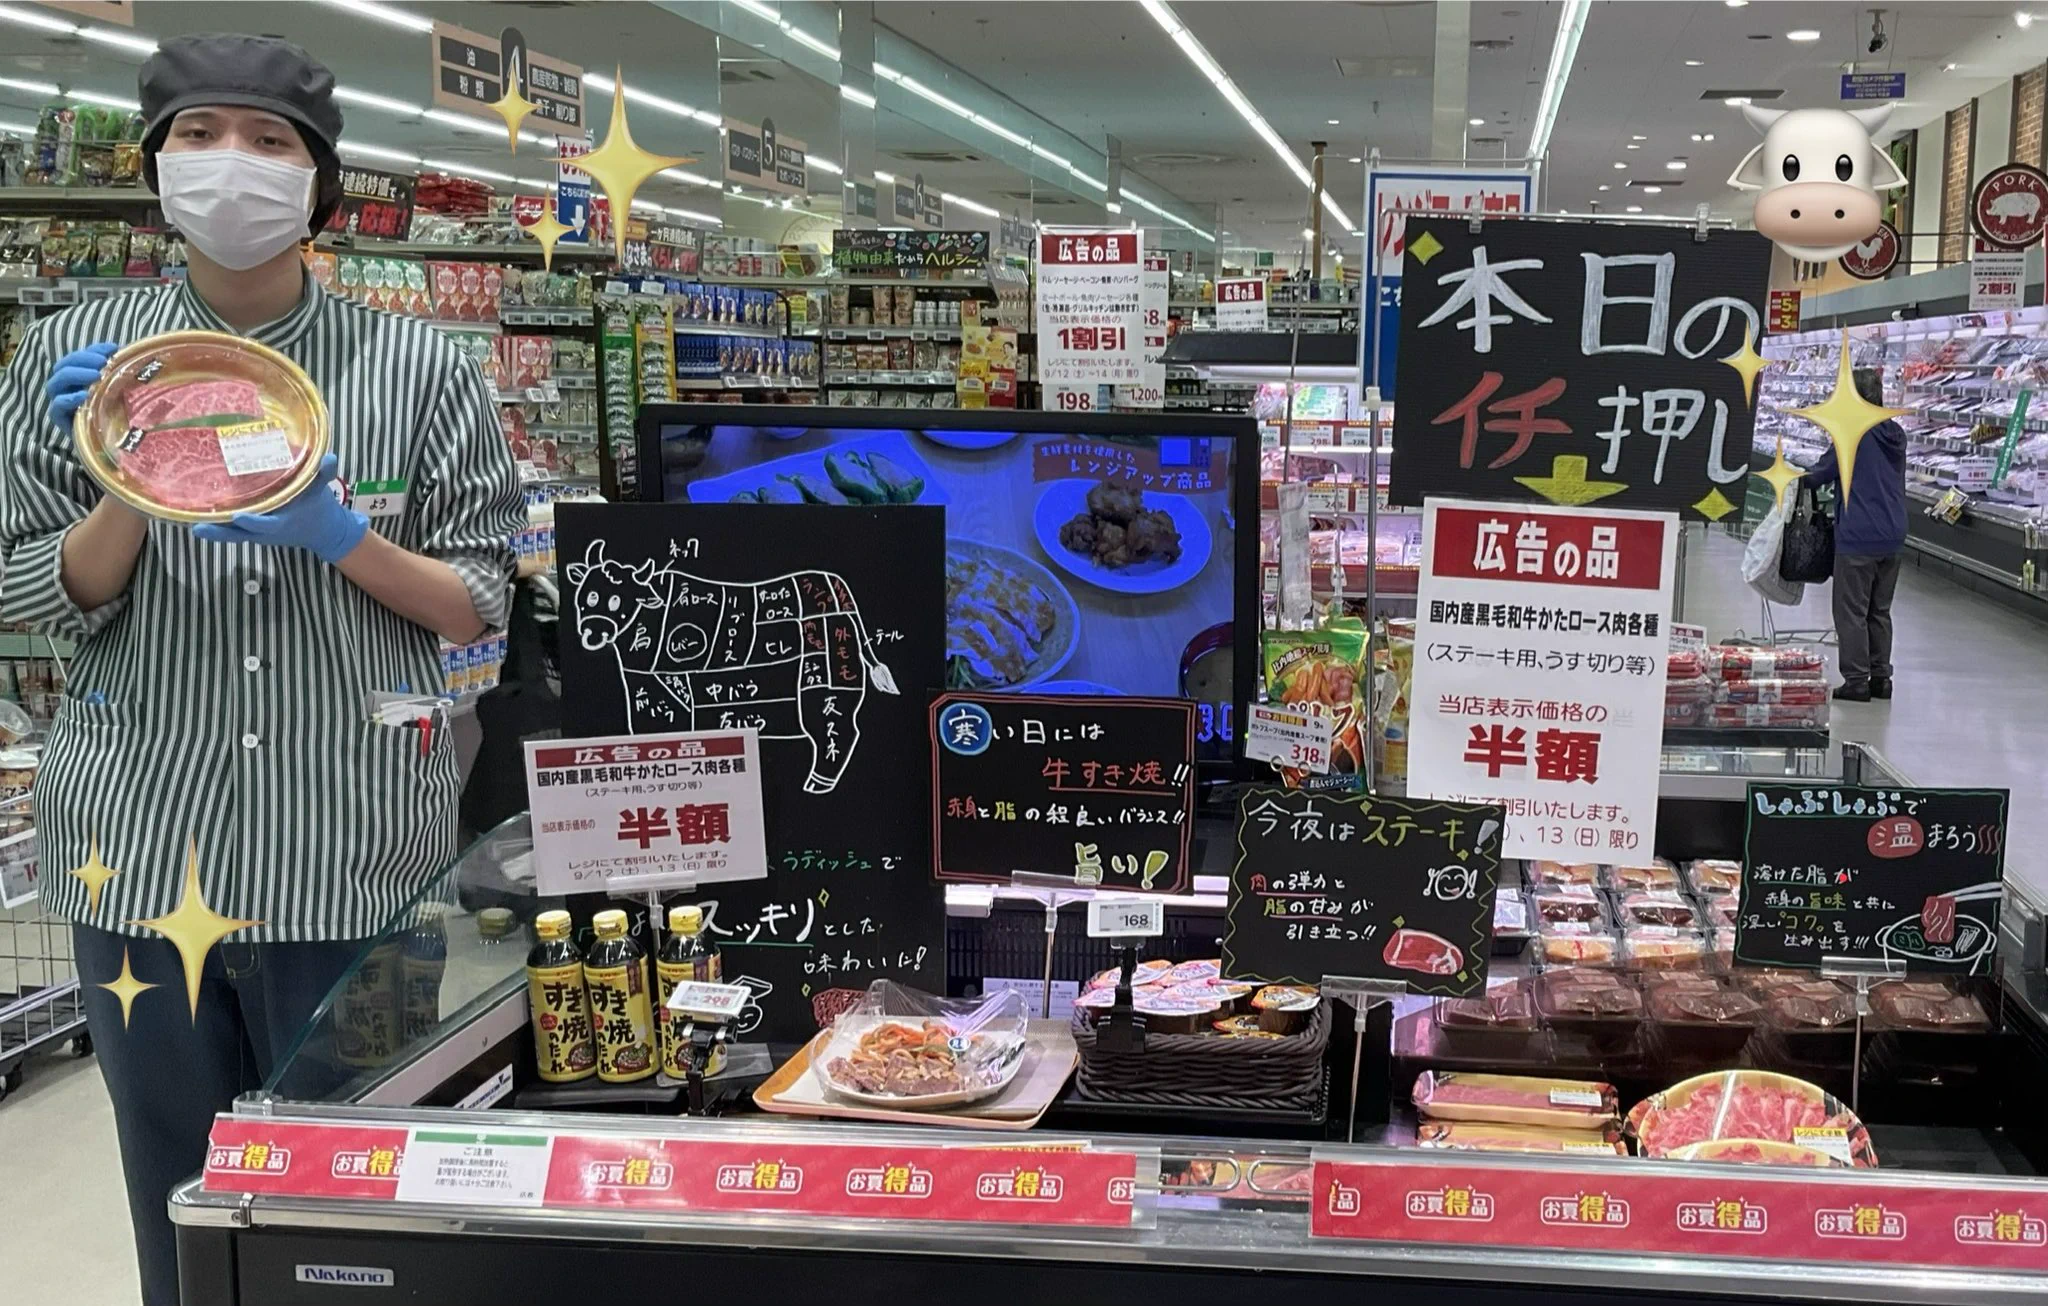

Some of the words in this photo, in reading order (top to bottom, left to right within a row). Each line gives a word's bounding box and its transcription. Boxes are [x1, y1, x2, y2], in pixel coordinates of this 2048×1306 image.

[465, 46, 477, 67] 油
[459, 74, 485, 100] 粉類
[764, 130, 773, 165] 5
[915, 182, 923, 204] 6
[1992, 174, 2040, 192] PORK
[1058, 237, 1121, 262] 広告の品
[1417, 245, 1760, 359] 本日の
[1057, 326, 1126, 351] 1割引
[1069, 459, 1212, 490] レンジアップ商品
[669, 537, 699, 559] ネック
[1473, 518, 1620, 580] 広告の品
[672, 581, 719, 608] 肩ロース
[802, 578, 834, 614] ランプ
[1429, 599, 1660, 638] 国内産黒毛和牛かたロース肉各種
[629, 622, 652, 652] 肩
[670, 635, 698, 653] レバー
[765, 639, 793, 656] ヒレ
[875, 627, 905, 645] テール
[834, 626, 858, 681] 外モモ
[705, 680, 760, 702] 中バラ
[1438, 694, 1608, 723] 当店表示価格の
[948, 708, 1105, 746] 寒い日には
[573, 740, 707, 764] 広告の品
[1463, 723, 1602, 785] 半額
[536, 757, 747, 787] 国内産黒毛和牛かたロース肉各種
[1754, 790, 1928, 816] しゃぶしゃぶで
[541, 818, 596, 834] 当店表示価格の
[617, 802, 732, 850] 半額
[1248, 799, 1500, 855] 今夜はステーキ!
[1873, 822, 1977, 853] 温まろう
[567, 849, 730, 870] レジにて割引いたします。
[783, 850, 902, 871] ラディッシュで
[1250, 871, 1346, 892] 肉の弾力と
[1753, 865, 1860, 885] 溶けた脂が
[1263, 898, 1375, 916] 脂の甘みが
[1764, 891, 1896, 911] 赤身の旨味と共に
[210, 1143, 285, 1170] お買得品
[591, 1158, 667, 1186] お買得品
[720, 1162, 796, 1190] お買得品
[850, 1166, 926, 1193] お買得品
[980, 1170, 1057, 1197] お買得品
[1409, 1188, 1488, 1216] お買得品
[1544, 1195, 1624, 1223] お買得品
[1680, 1200, 1762, 1229] お買得品
[1819, 1206, 1901, 1236] お買得品
[1958, 1213, 2041, 1242] お買得品
[304, 1268, 385, 1283] Nakano
